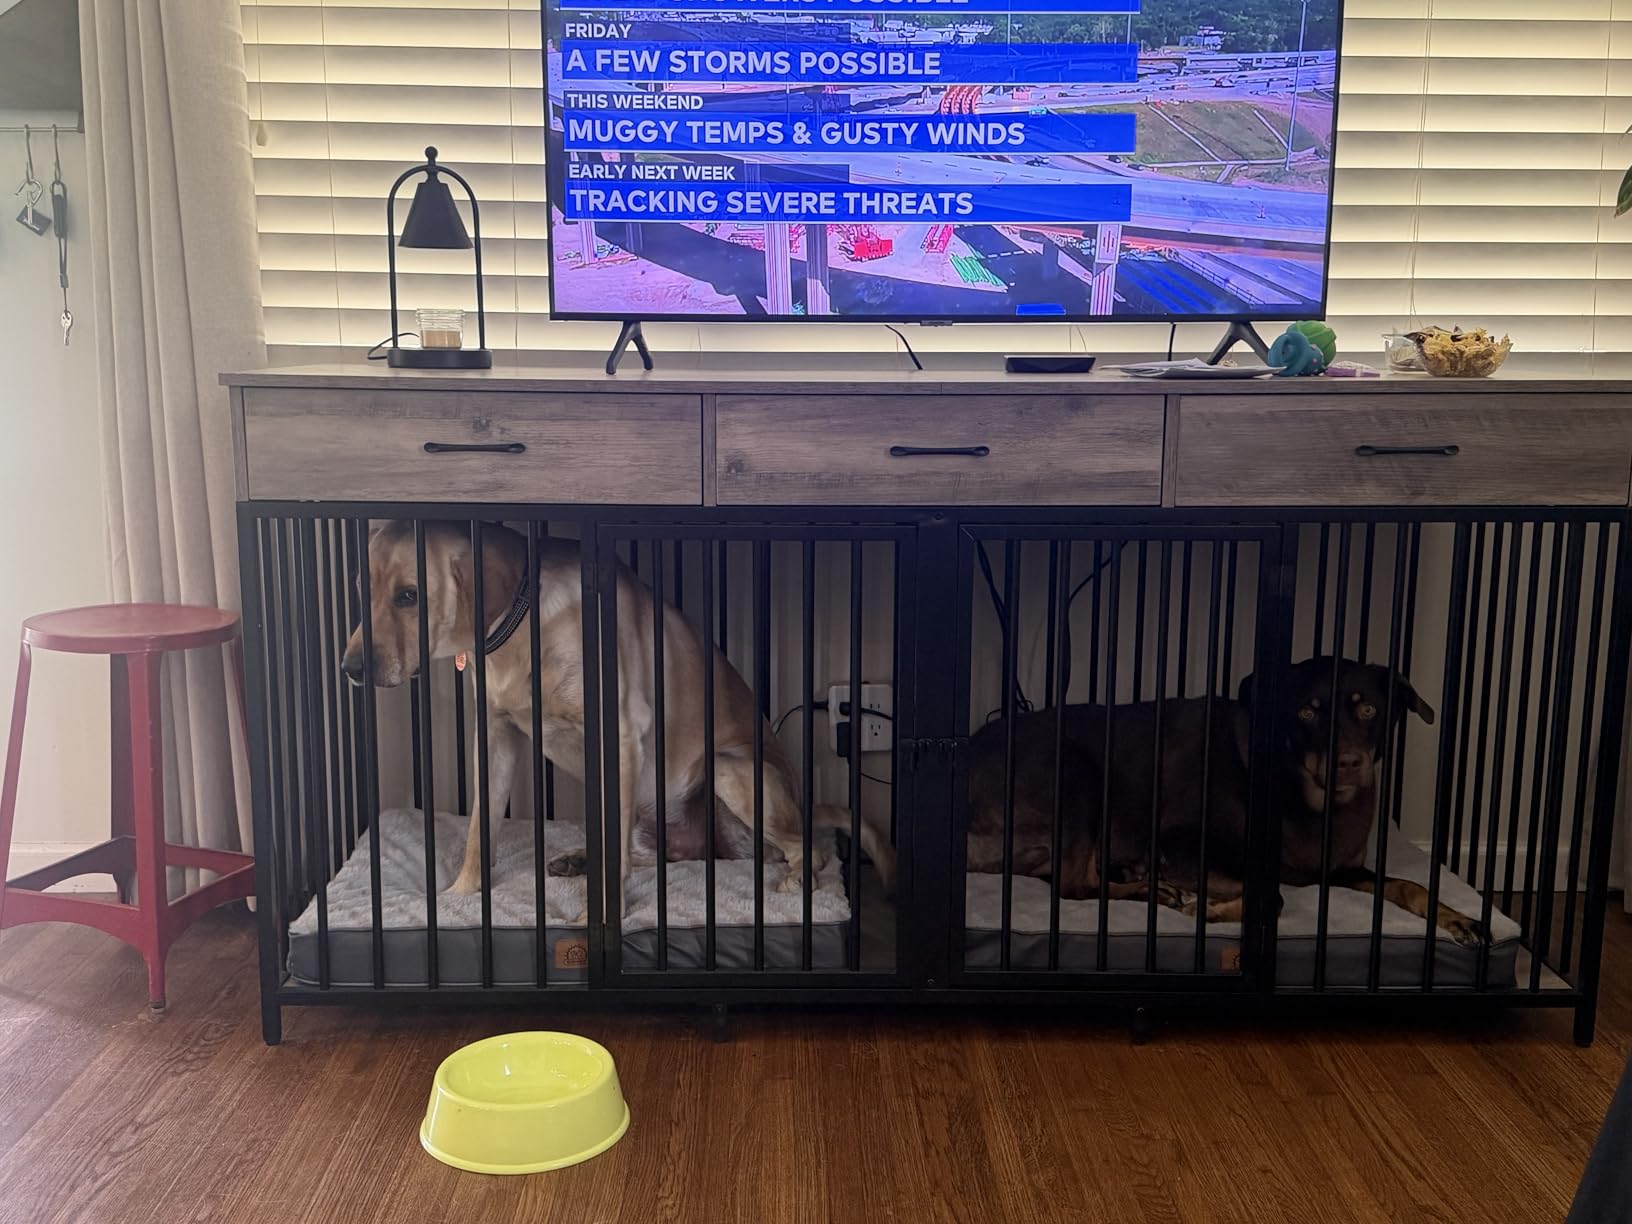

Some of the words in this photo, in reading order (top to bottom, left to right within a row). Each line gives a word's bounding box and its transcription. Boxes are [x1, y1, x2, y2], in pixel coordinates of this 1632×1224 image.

[565, 23, 632, 39] FRIDAY
[566, 49, 587, 72] A
[595, 49, 661, 73] FEW
[669, 50, 791, 75] STORMS
[800, 51, 941, 75] POSSIBLE
[566, 93, 609, 109] THIS
[612, 94, 704, 110] WEEKEND
[569, 119, 679, 143] MUGGY
[686, 120, 784, 144] TEMPS
[792, 121, 812, 145] &
[820, 122, 919, 145] GUSTY
[926, 122, 1025, 145] WINDS
[568, 164, 627, 179] EARLY
[631, 164, 679, 180] NEXT
[681, 165, 736, 181] WEEK
[569, 189, 718, 213] TRACKING
[726, 191, 836, 214] SEVERE
[842, 192, 973, 215] THREATS
